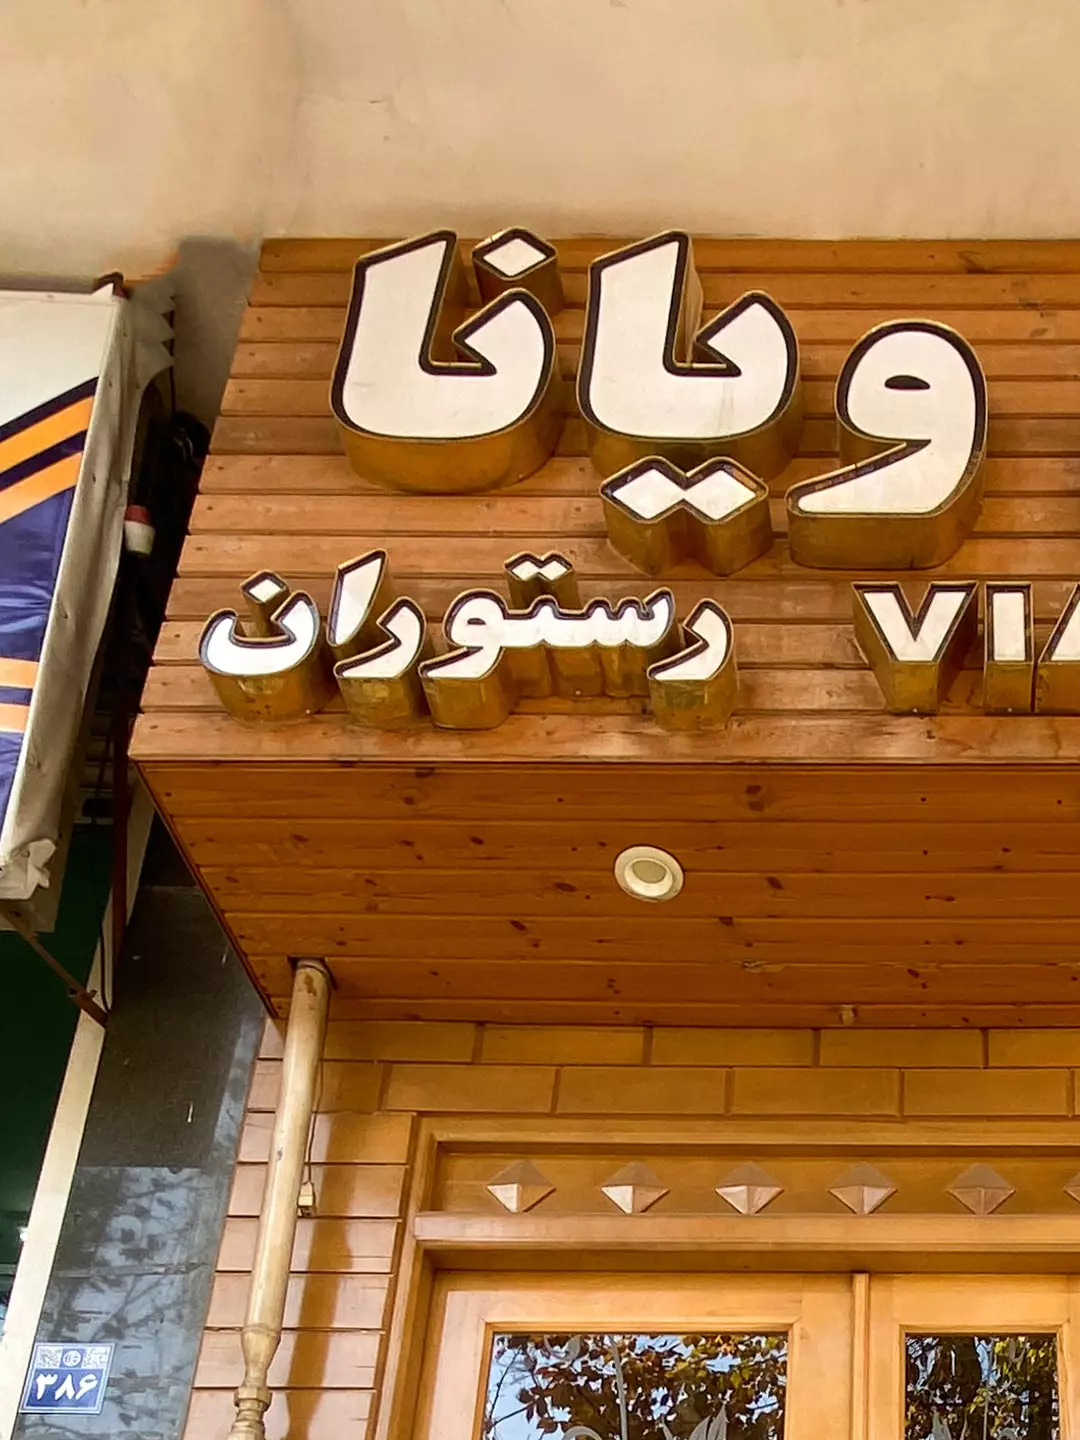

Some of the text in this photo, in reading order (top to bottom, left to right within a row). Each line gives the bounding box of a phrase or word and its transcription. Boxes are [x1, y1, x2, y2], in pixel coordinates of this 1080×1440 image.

[330, 228, 989, 525] ویانا
[199, 548, 734, 684] رستوران
[35, 1373, 98, 1401] ۳۸۶
